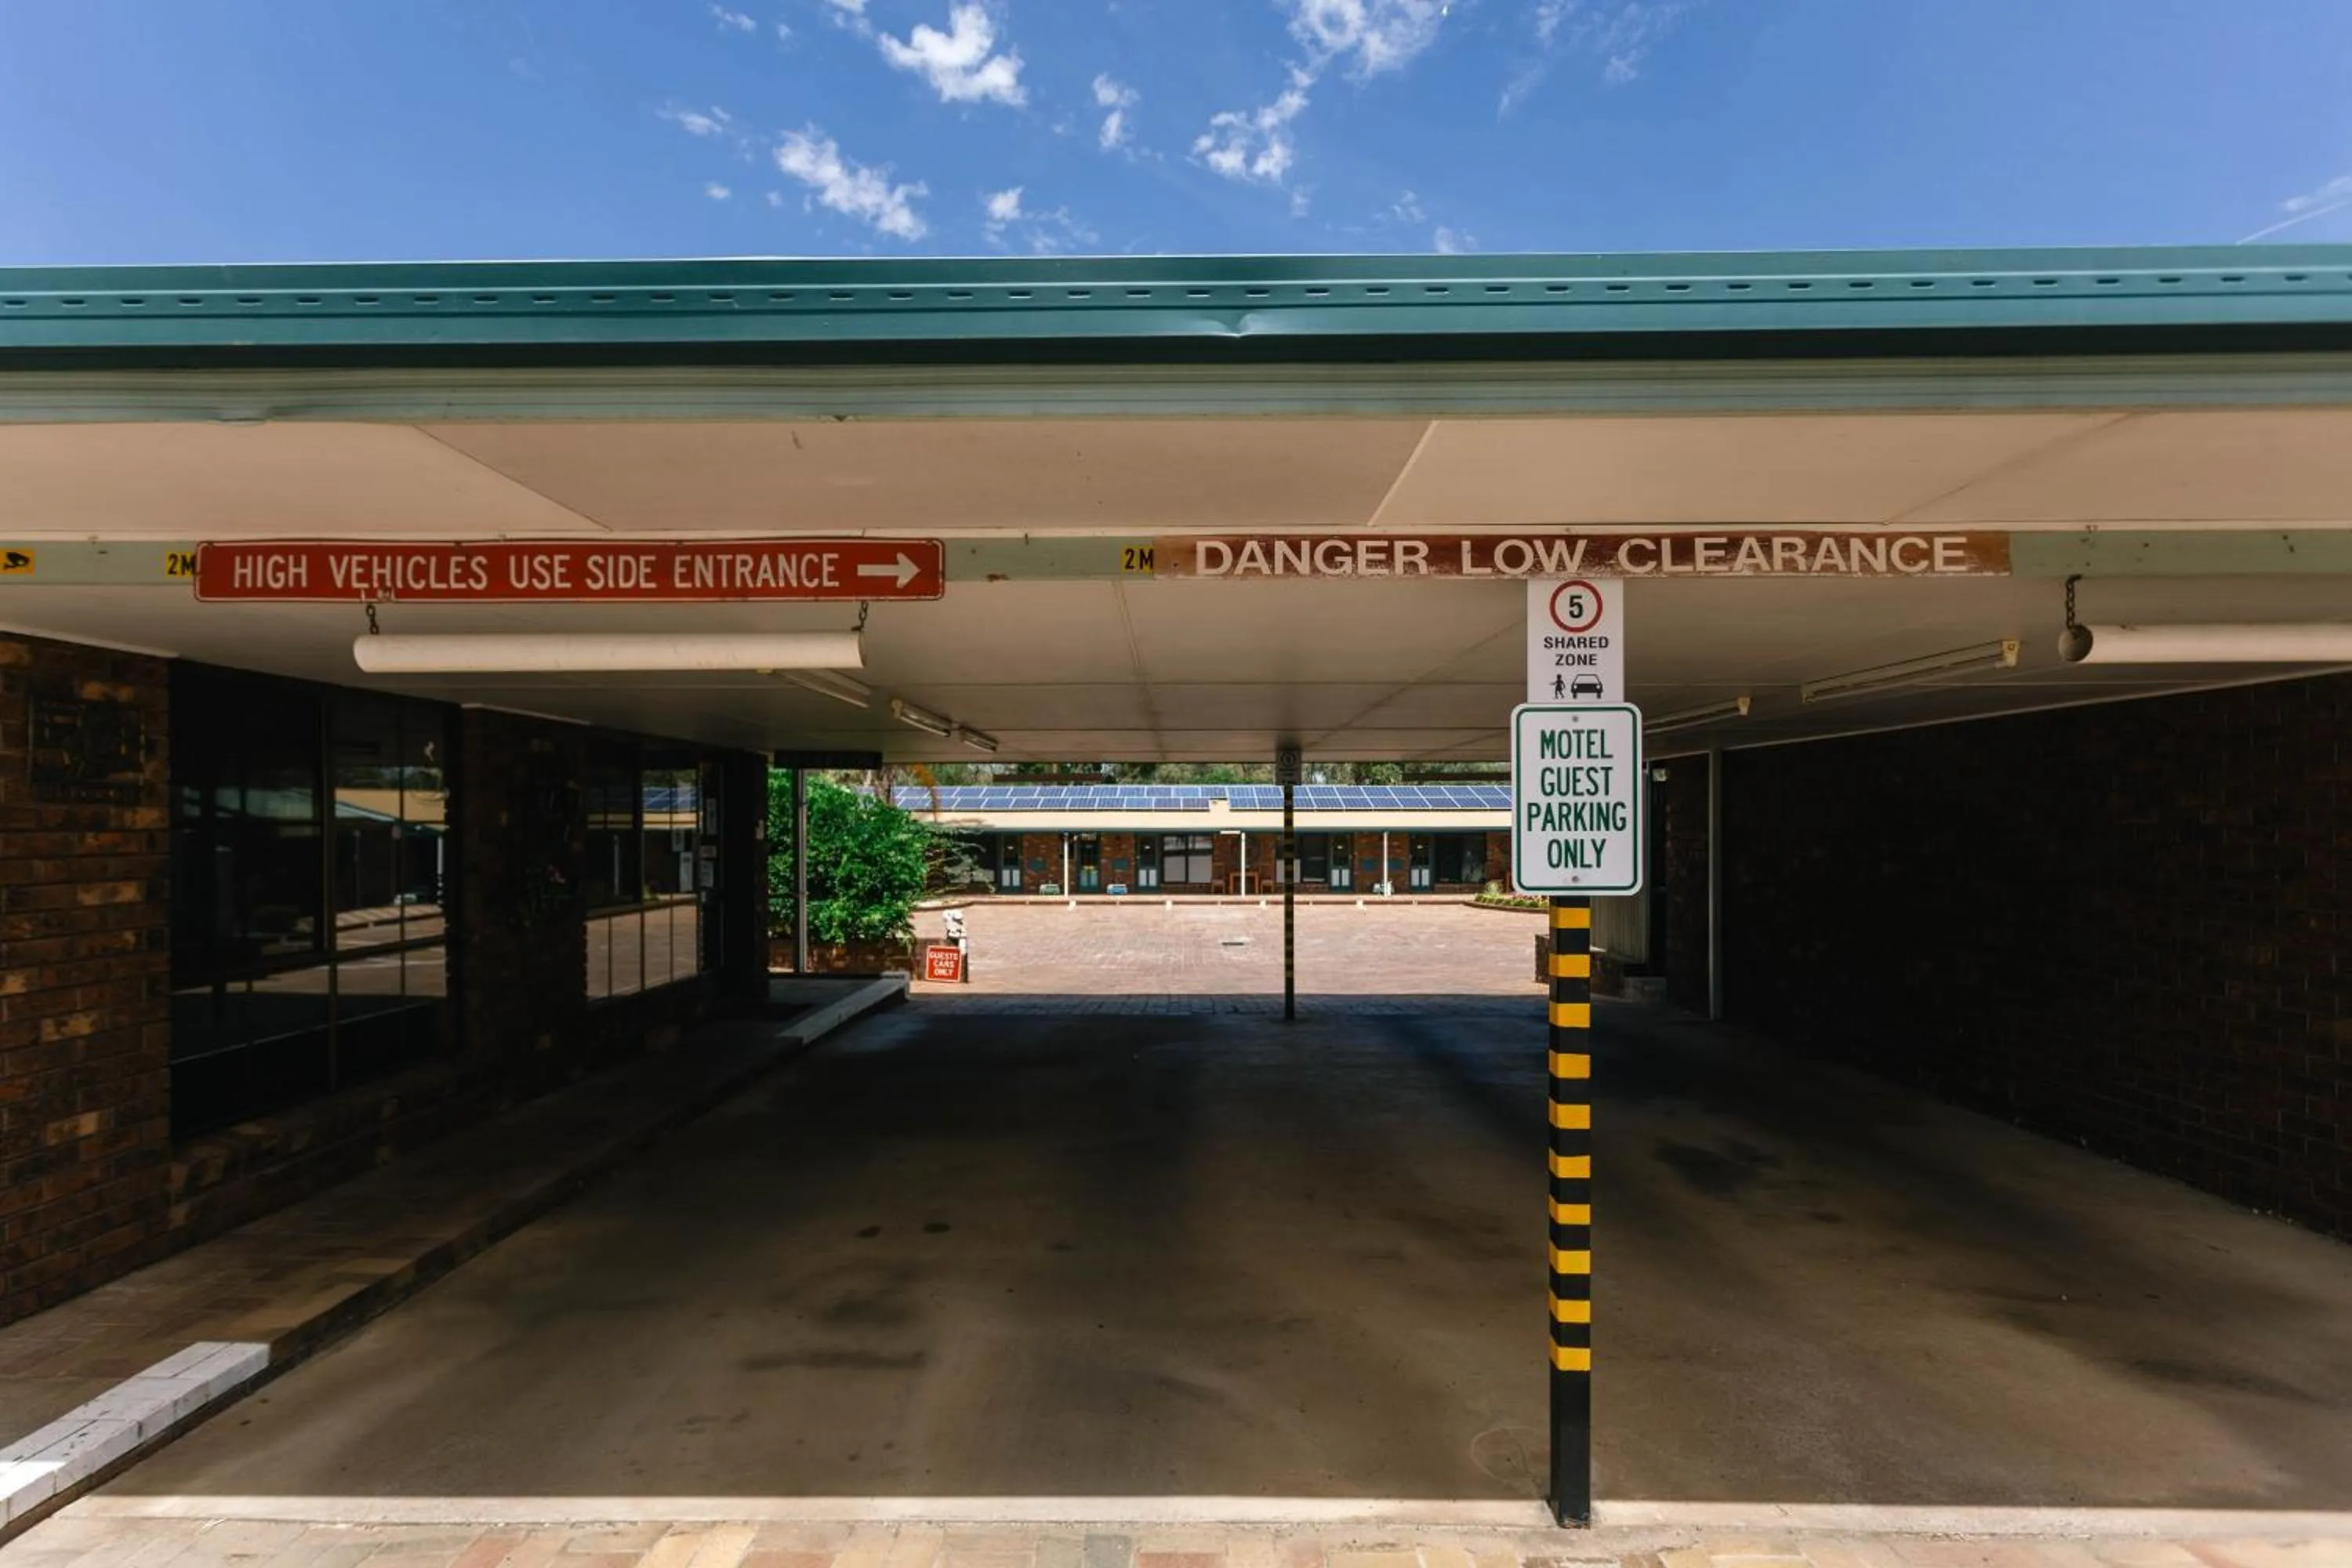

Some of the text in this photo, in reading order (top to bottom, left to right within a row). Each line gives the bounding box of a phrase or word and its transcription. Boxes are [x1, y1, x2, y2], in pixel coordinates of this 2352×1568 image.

[168, 553, 196, 575] 2M
[1124, 549, 1154, 571] 2M
[1195, 535, 1969, 576] DANGER LOW CLEARANCE
[234, 553, 840, 589] HIGH VEHICLES USE SIDE ENTRANCE
[1569, 595, 1584, 619] 5
[1543, 636, 1610, 649] SHARED
[1555, 653, 1598, 666] ZONE
[1541, 729, 1613, 760] MOTEL
[1541, 767, 1613, 797] GUEST
[1527, 801, 1628, 832] PARKING
[1547, 838, 1606, 869] ONLY
